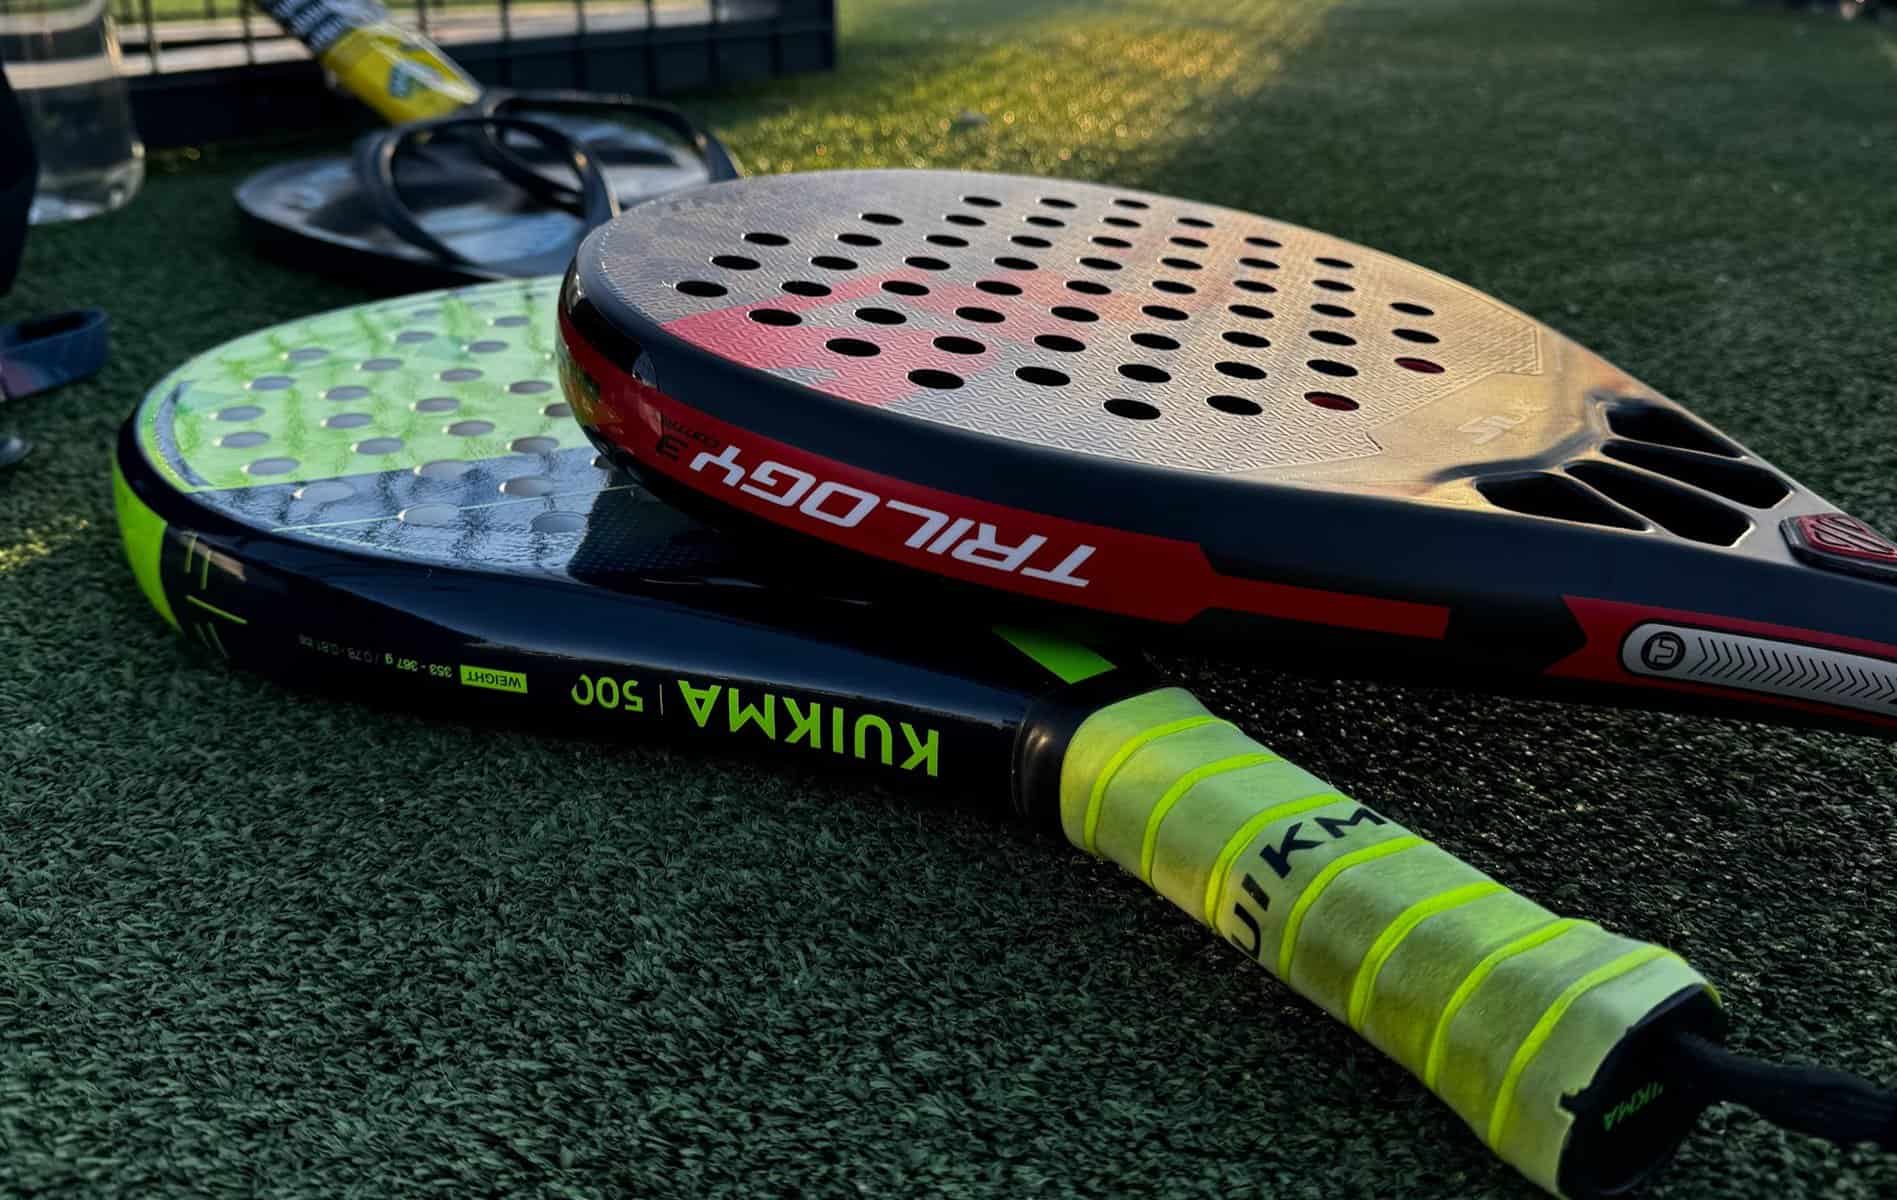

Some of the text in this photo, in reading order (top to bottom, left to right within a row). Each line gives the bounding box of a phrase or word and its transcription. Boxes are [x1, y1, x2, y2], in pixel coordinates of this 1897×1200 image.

[689, 445, 1096, 588] TRILOGY
[466, 671, 523, 689] WEIGHT
[570, 673, 940, 777] KUIKMA 500
